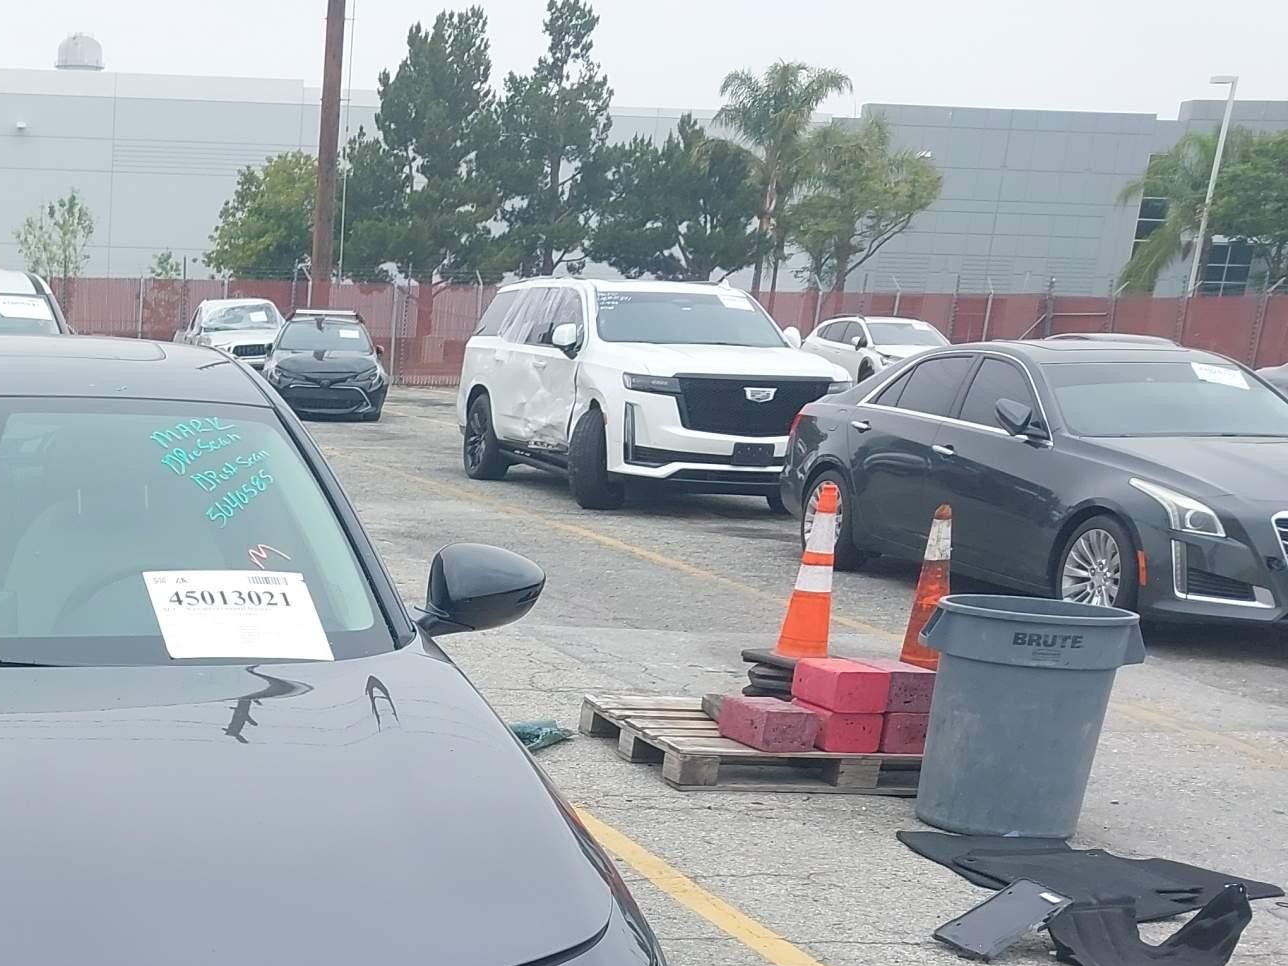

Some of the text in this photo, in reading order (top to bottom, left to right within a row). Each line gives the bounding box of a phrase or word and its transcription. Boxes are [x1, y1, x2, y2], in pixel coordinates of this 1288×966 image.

[150, 417, 238, 448] MARK
[168, 590, 292, 607] 45013021
[1013, 632, 1084, 648] BRUTE
